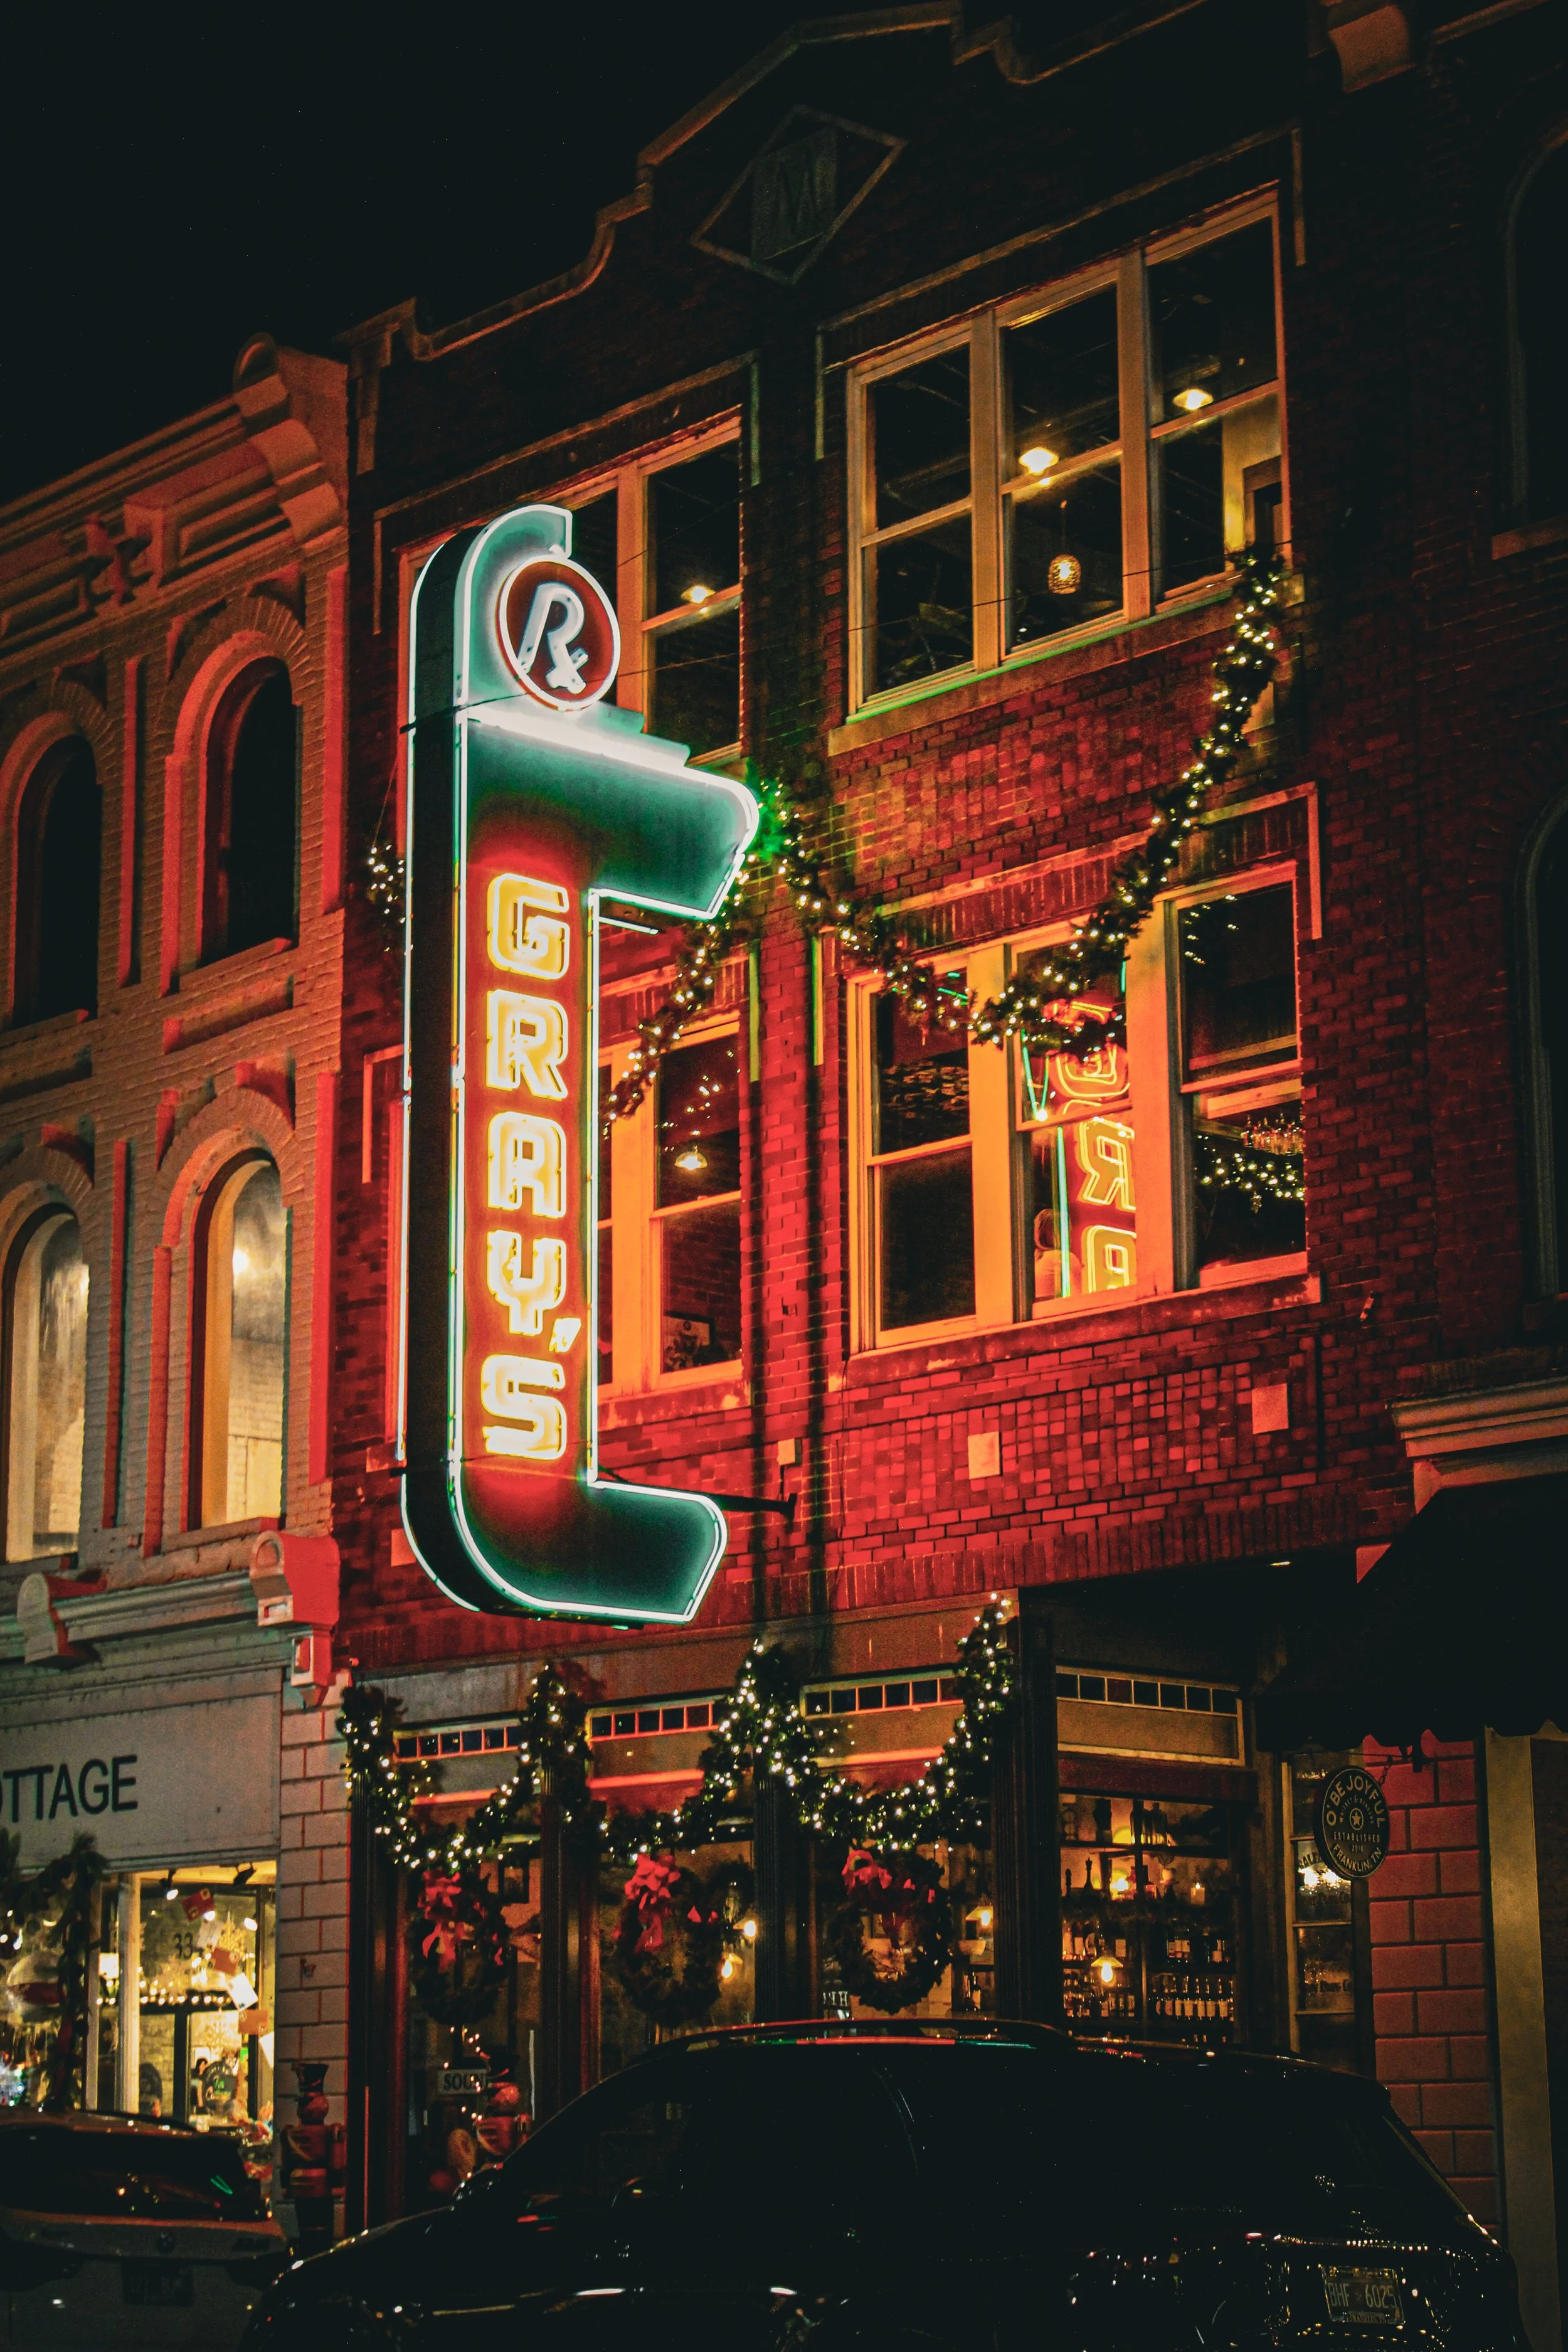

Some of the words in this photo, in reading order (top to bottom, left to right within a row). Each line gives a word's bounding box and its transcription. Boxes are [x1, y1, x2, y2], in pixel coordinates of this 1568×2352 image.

[480, 872, 581, 1460] GRAY'S
[0, 1754, 138, 1823] TTAGE
[1346, 1774, 1386, 1828] JOYFUL
[1333, 1831, 1381, 1843] ESTABLISHED
[1370, 1846, 1383, 1864] TN
[1365, 2283, 1397, 2309] 6025
